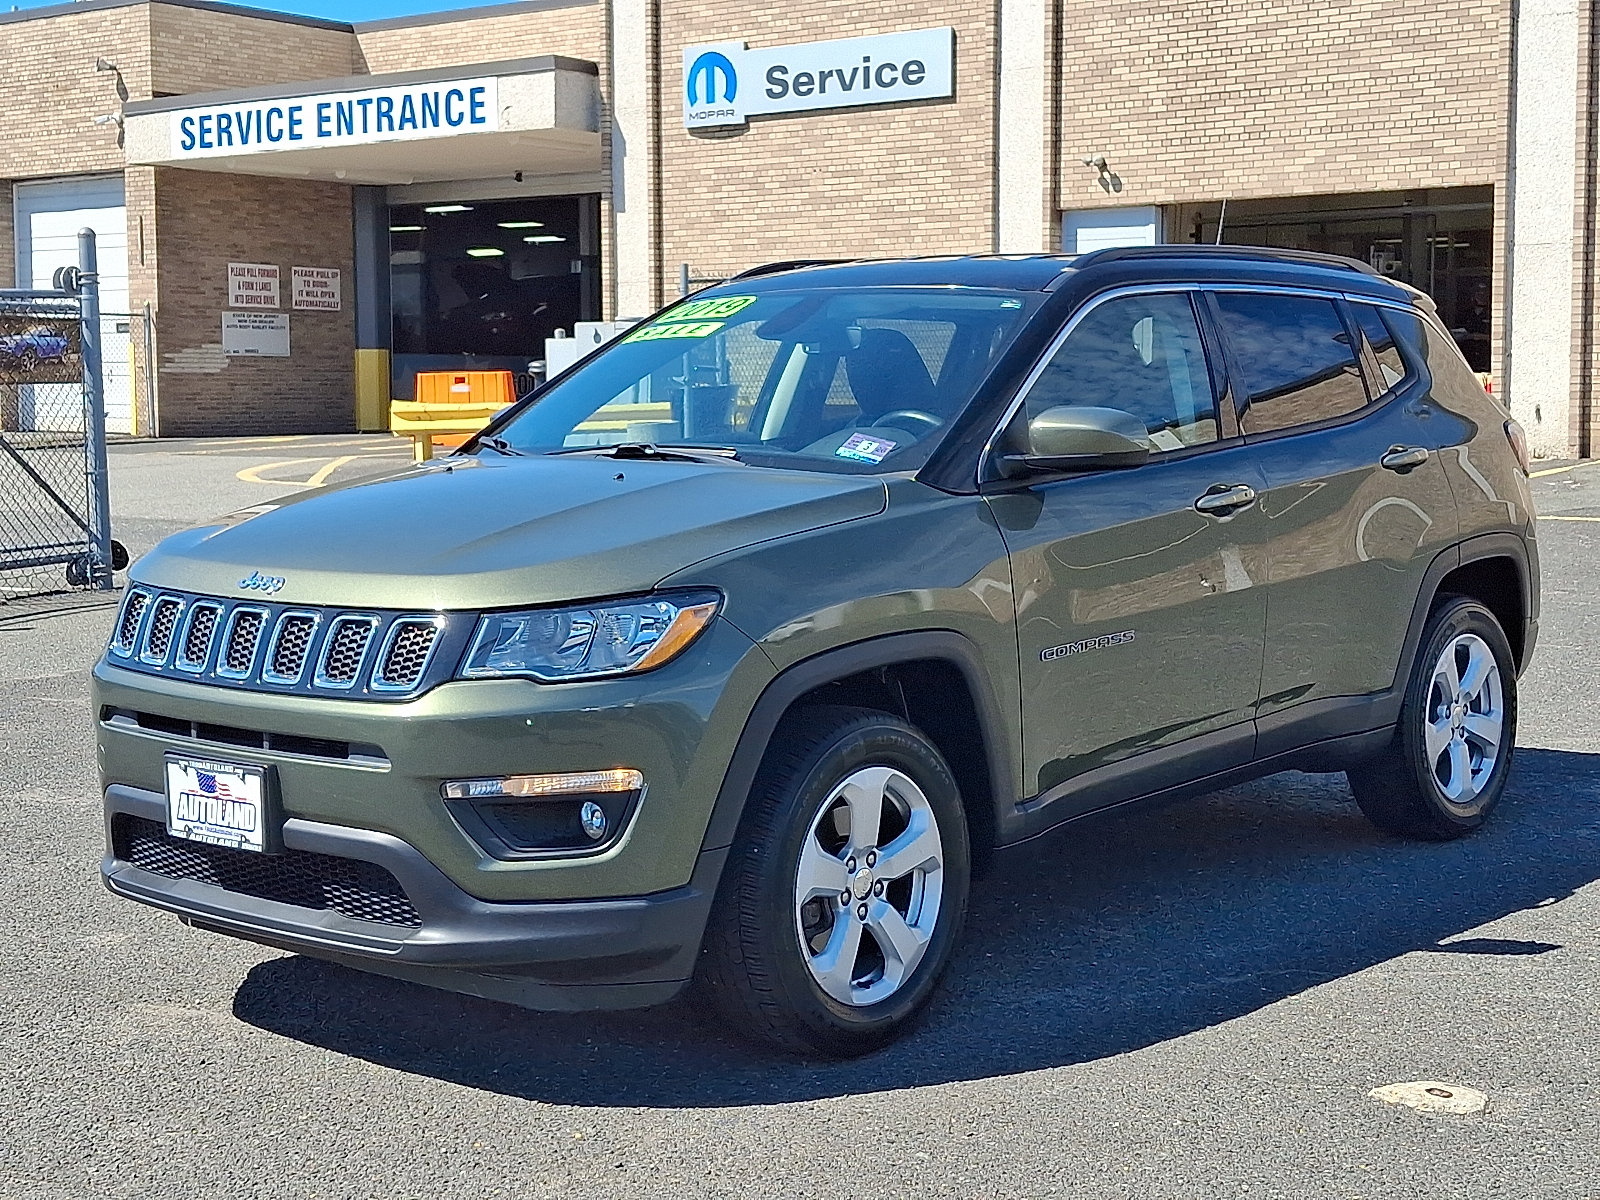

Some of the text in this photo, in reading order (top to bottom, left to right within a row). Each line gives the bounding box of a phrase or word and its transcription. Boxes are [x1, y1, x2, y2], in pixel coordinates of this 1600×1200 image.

[765, 55, 926, 100] Service
[180, 86, 487, 151] SERVICE ENTRANCE
[688, 109, 735, 121] MOPAR
[230, 267, 246, 277] PLEASE
[247, 267, 257, 278] PULL
[293, 269, 339, 279] PLEASE PULL UP
[303, 279, 311, 288] TO
[234, 294, 276, 306] INTO SERVICE DRIVE
[298, 289, 335, 299] IT WILL OPEN
[294, 299, 340, 309] AUTOMATICALLY
[862, 442, 873, 451] 3
[236, 570, 287, 596] Jeep
[1040, 629, 1136, 662] COMPASS
[177, 792, 257, 832] AUTOLAND
[188, 832, 239, 848] AUTOLAND
